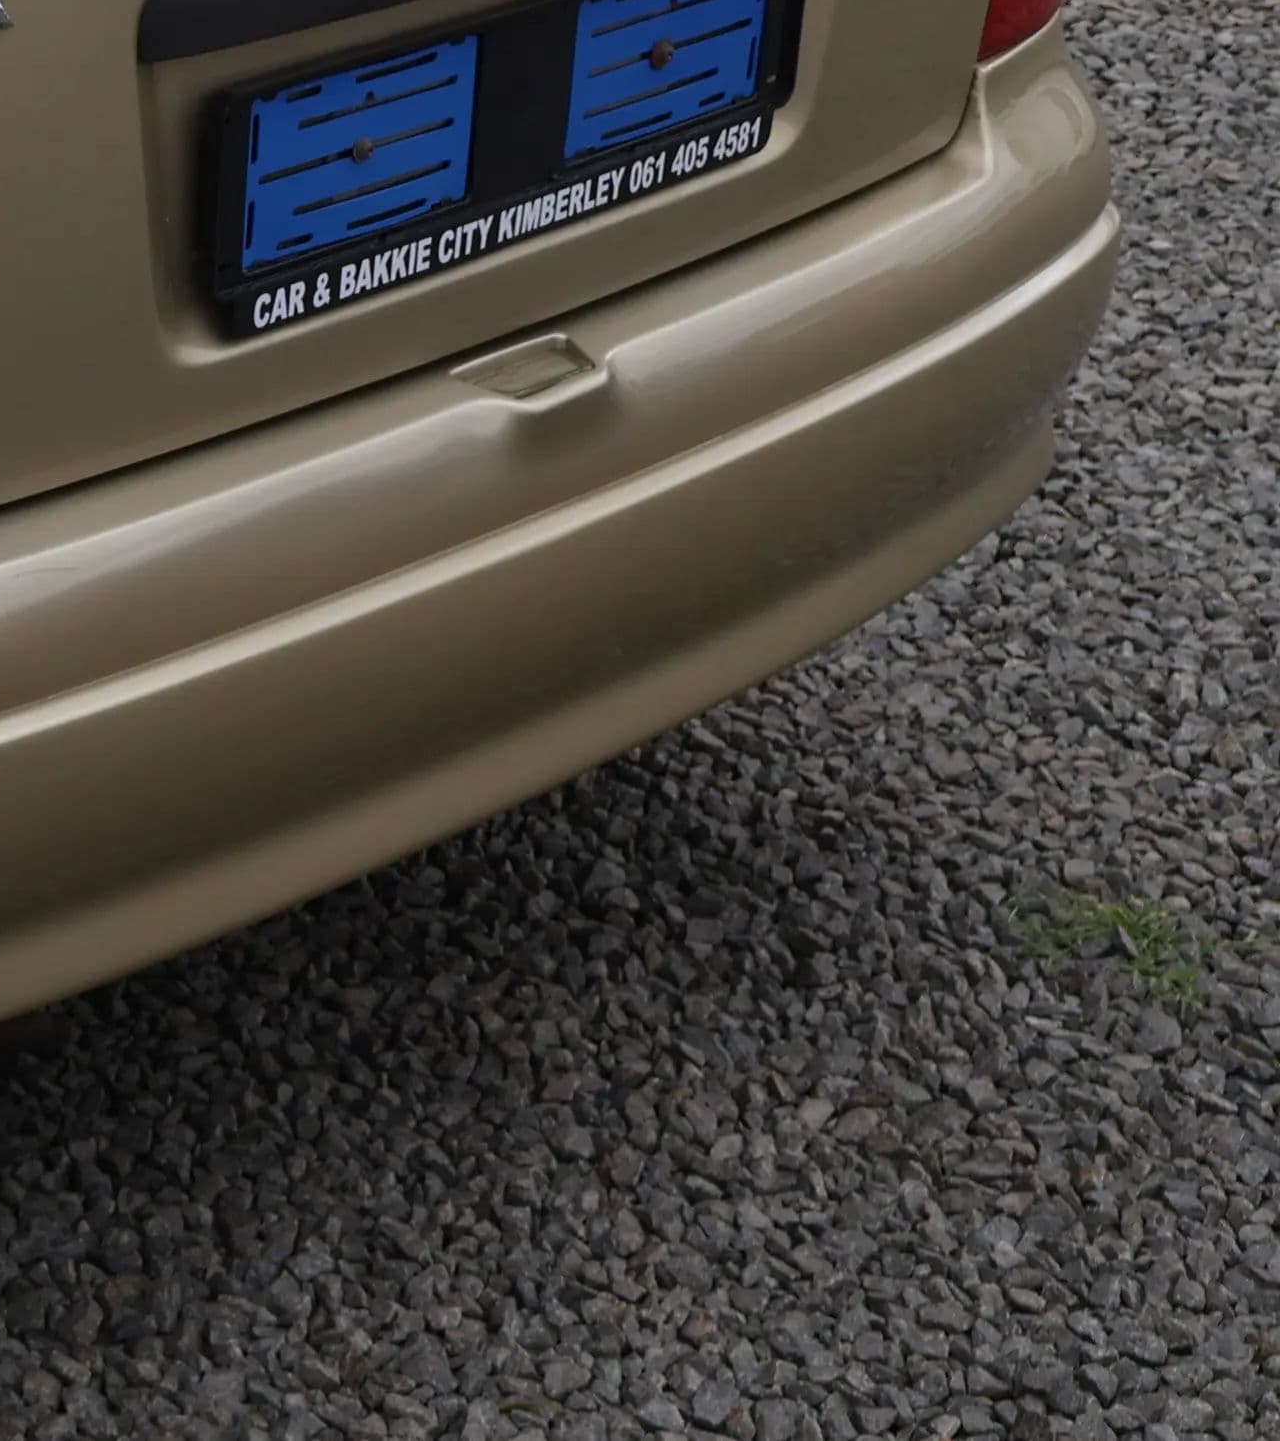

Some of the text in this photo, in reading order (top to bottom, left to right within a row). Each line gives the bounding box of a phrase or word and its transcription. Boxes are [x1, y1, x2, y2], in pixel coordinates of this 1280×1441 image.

[253, 116, 762, 329] CAR & BAKKIE CITY KIMBERLEY 061 405 4581
